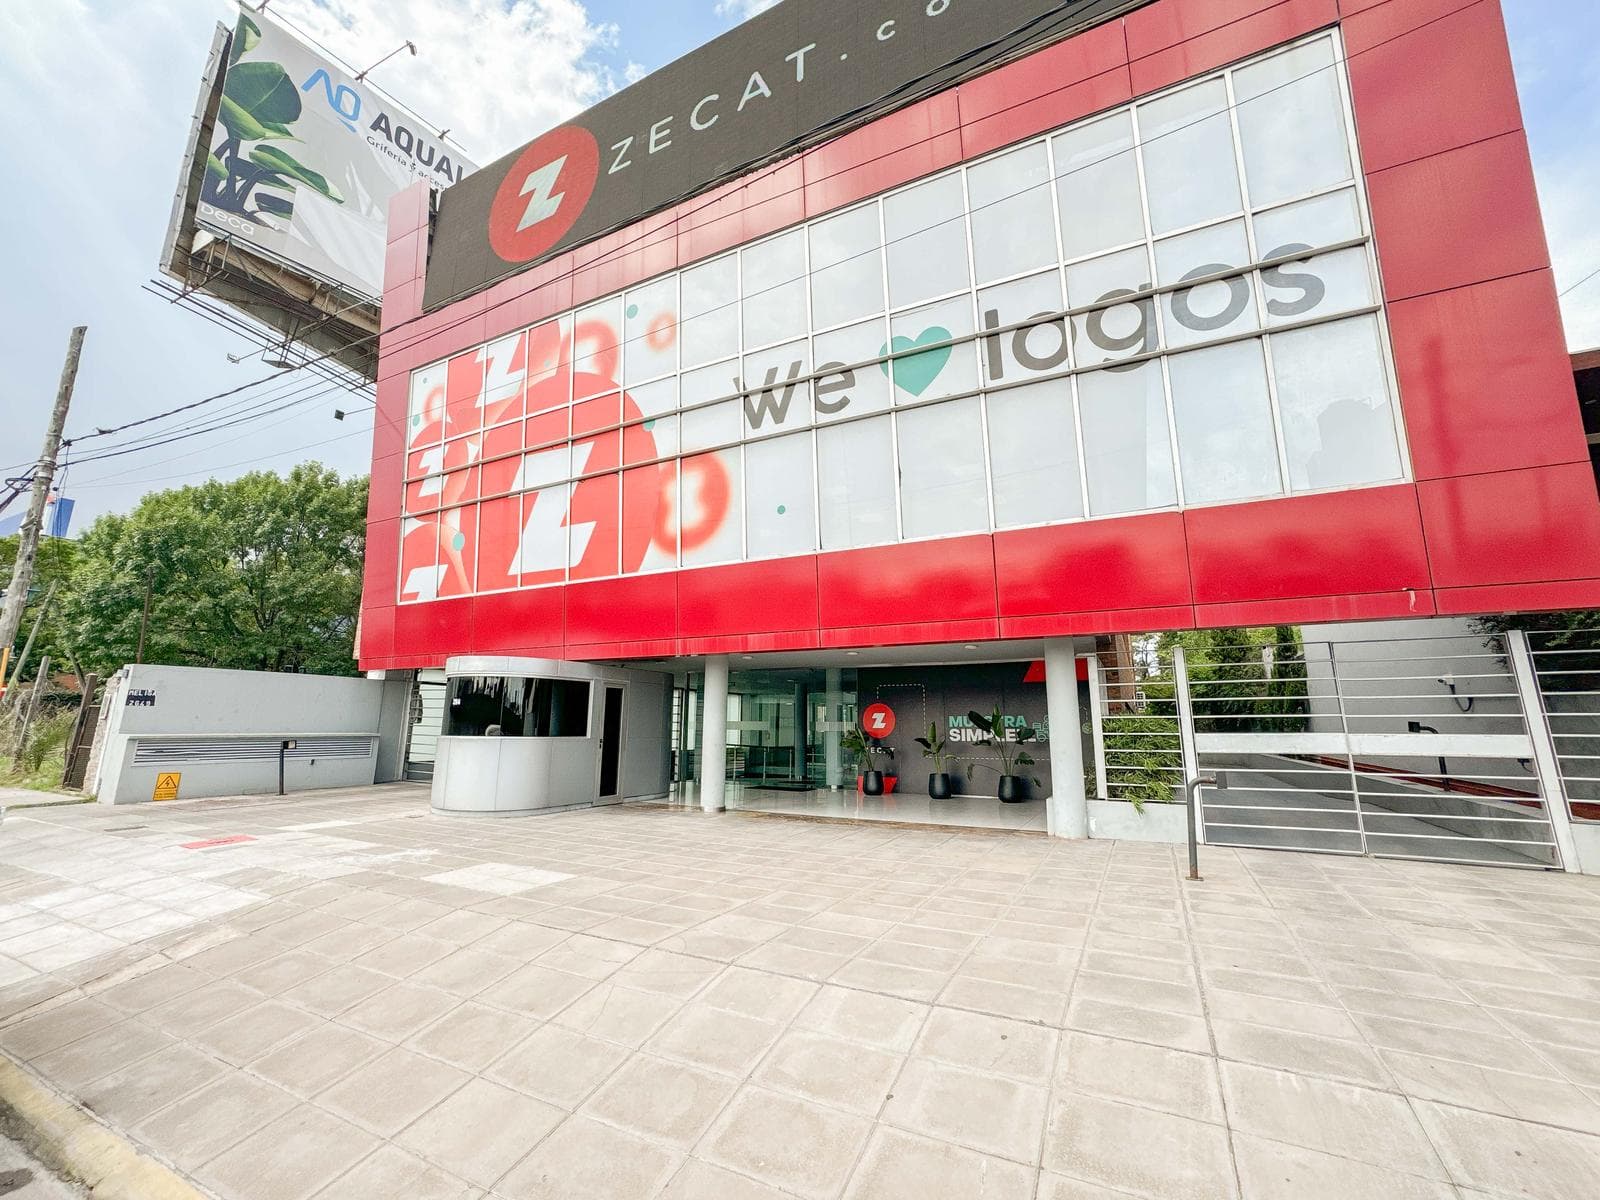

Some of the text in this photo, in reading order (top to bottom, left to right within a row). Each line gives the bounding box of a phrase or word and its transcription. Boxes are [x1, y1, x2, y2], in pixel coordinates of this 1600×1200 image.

[732, 242, 1326, 429] we logos
[949, 715, 1028, 727] MURA
